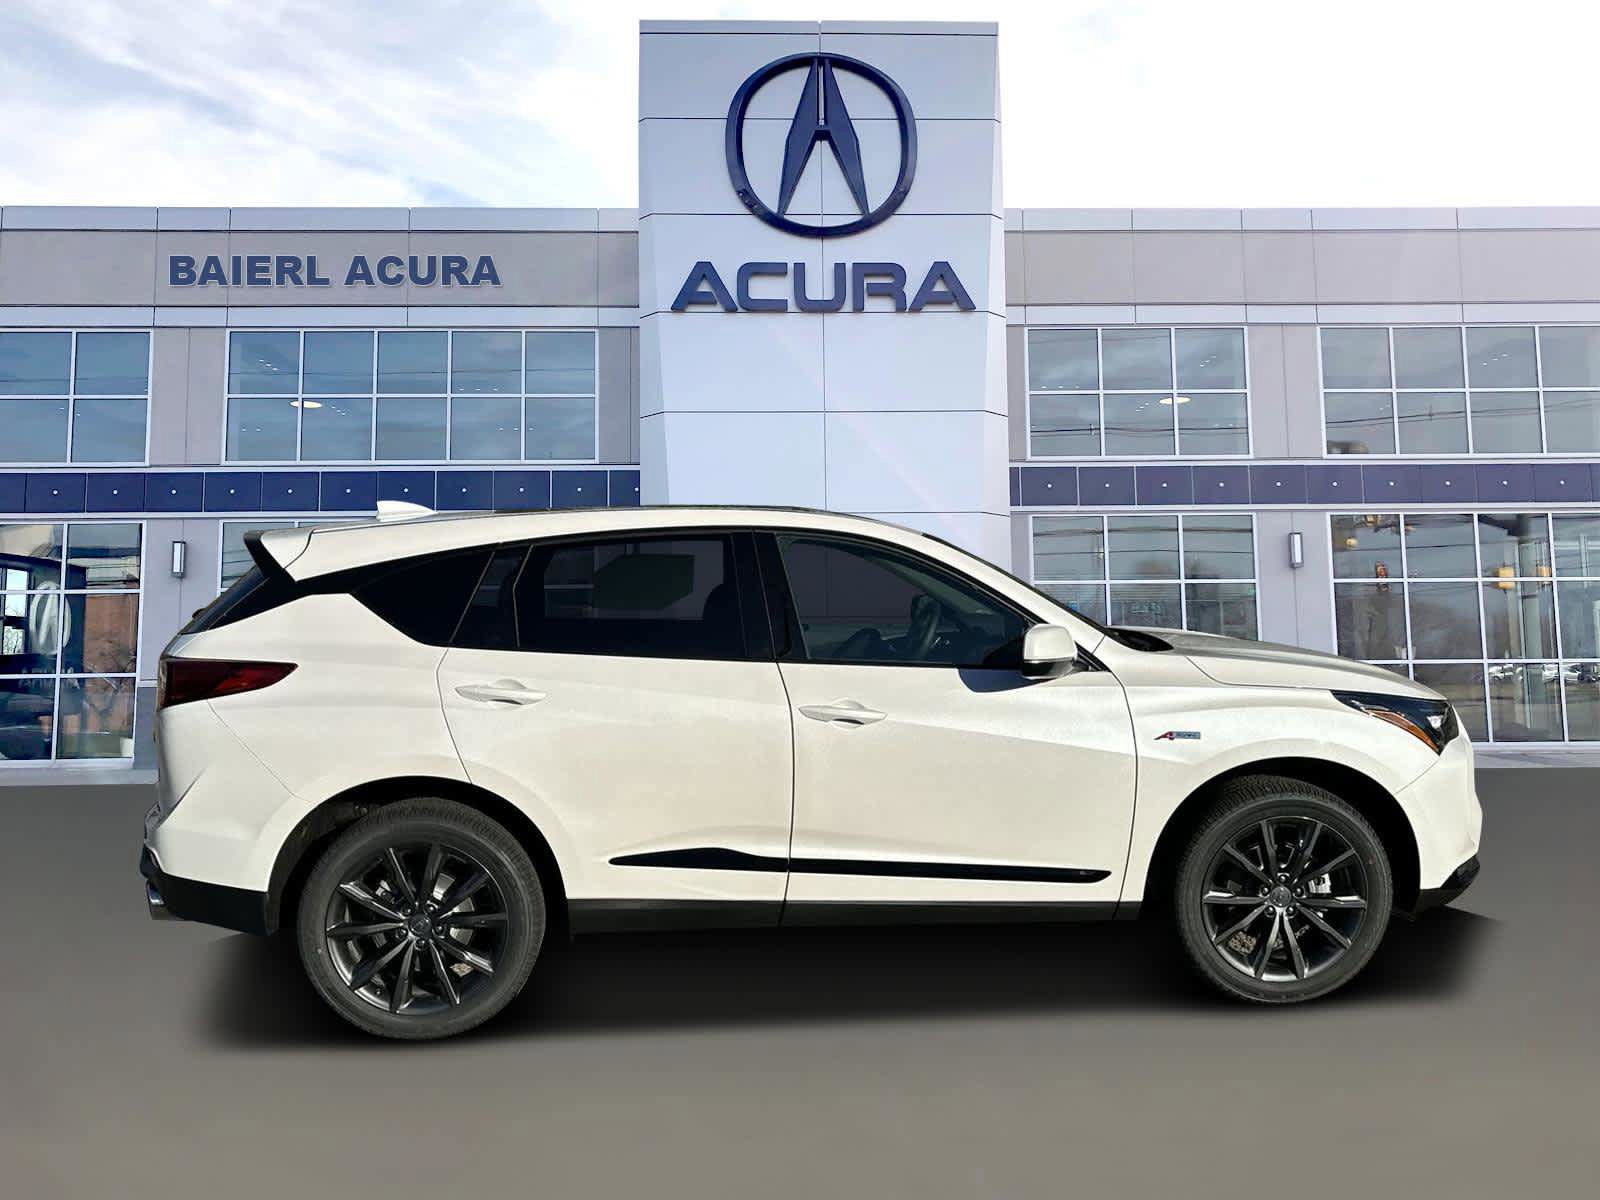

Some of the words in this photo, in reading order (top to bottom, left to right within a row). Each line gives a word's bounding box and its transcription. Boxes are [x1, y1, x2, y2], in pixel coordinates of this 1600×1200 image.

[168, 254, 331, 287] BAIERL
[343, 254, 502, 287] ACURA
[670, 260, 977, 313] ACURA
